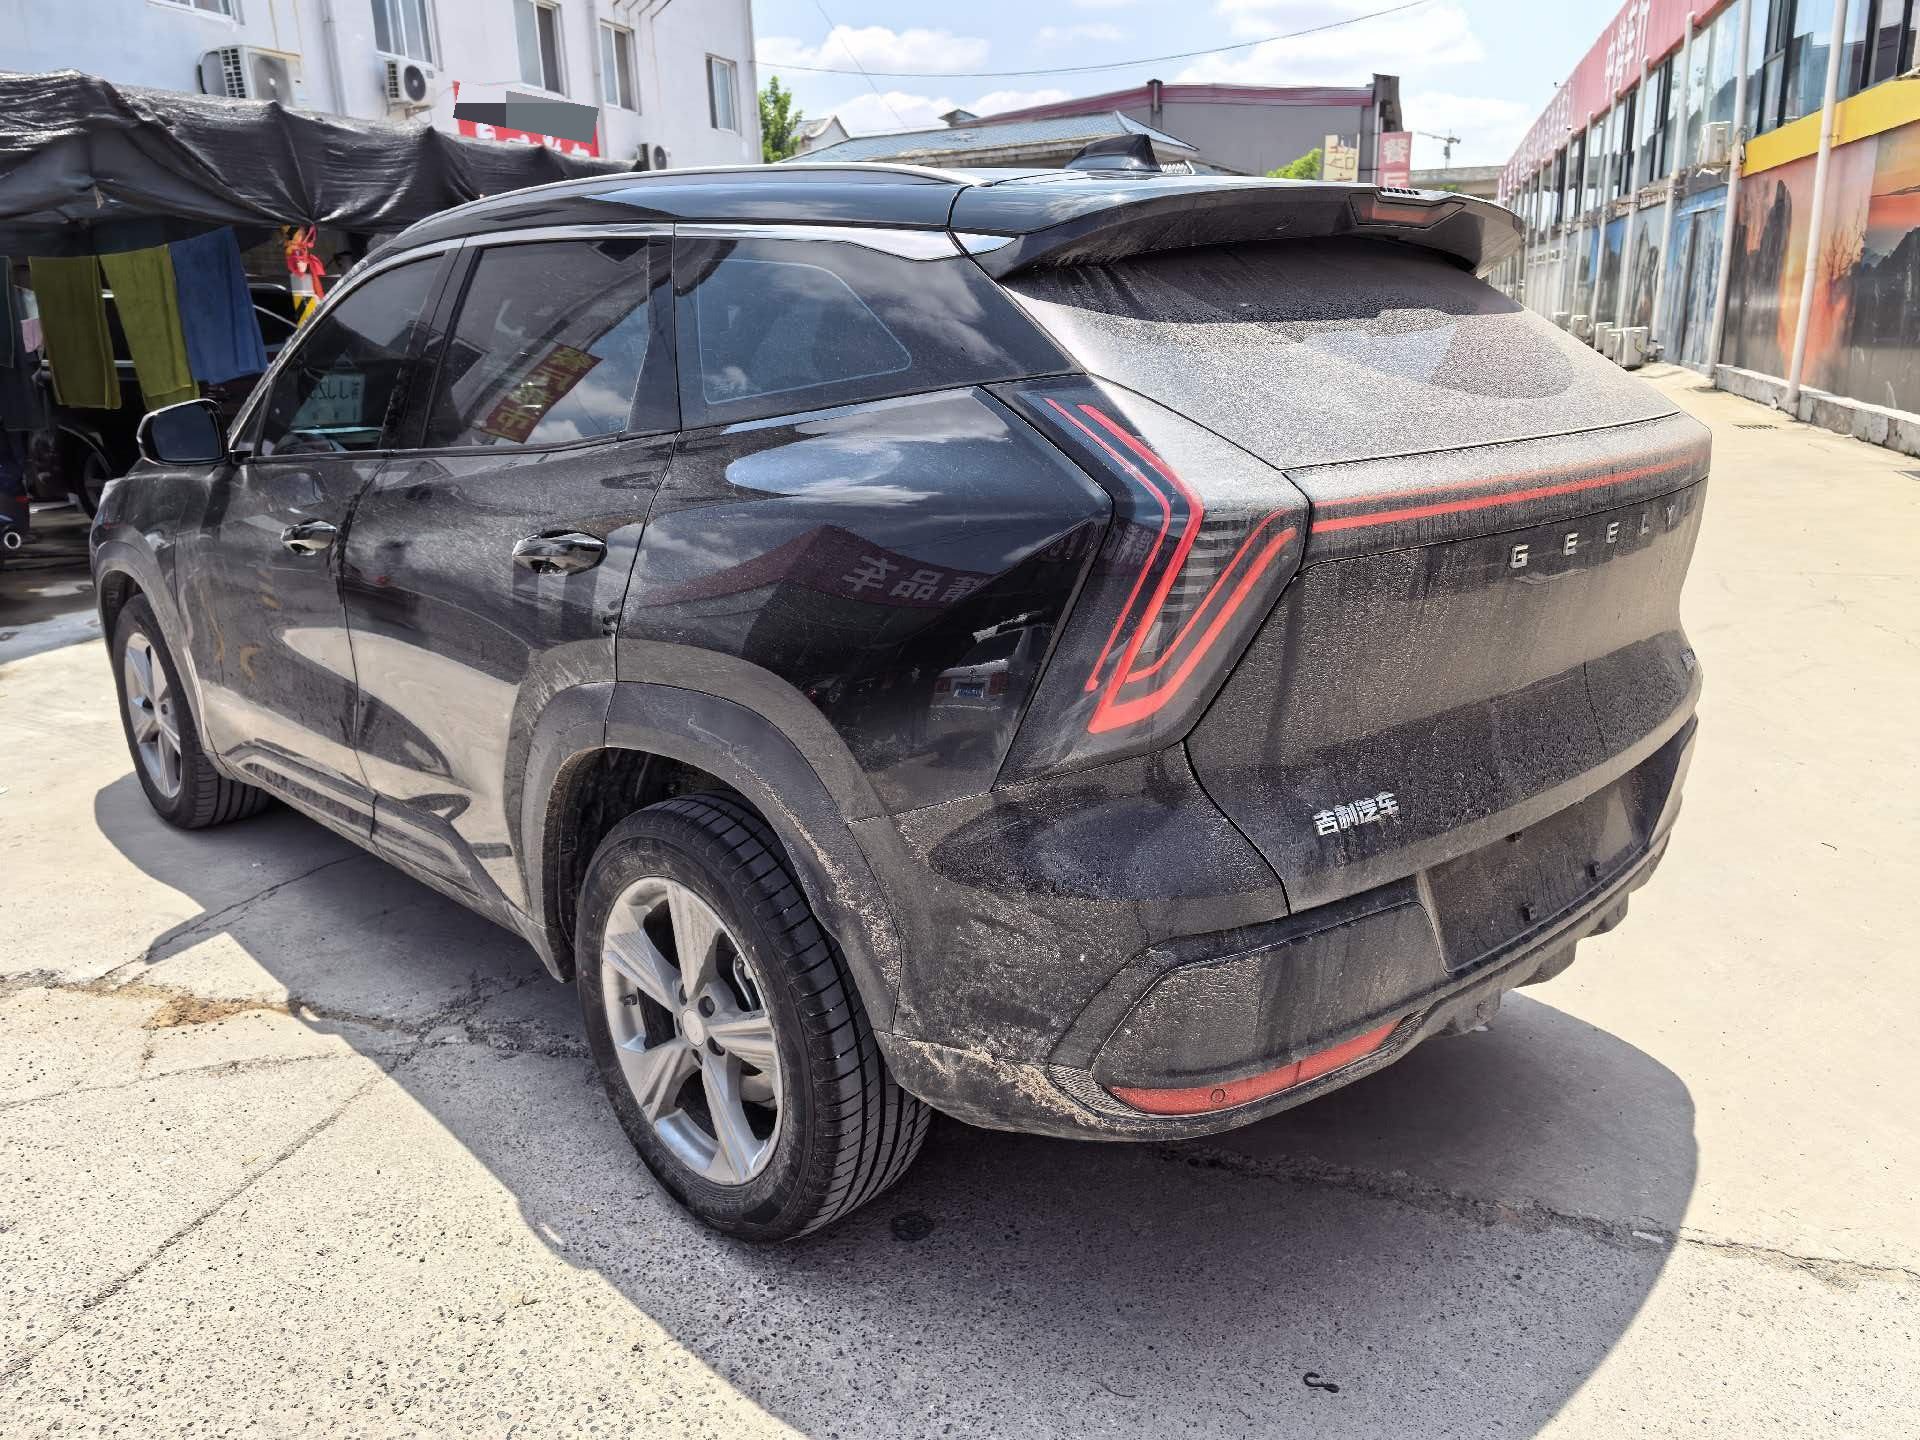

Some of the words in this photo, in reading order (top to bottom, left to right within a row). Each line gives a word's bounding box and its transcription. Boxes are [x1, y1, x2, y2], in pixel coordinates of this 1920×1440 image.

[1510, 504, 1675, 569] GEELY
[1312, 791, 1400, 836] 吉利汽车
